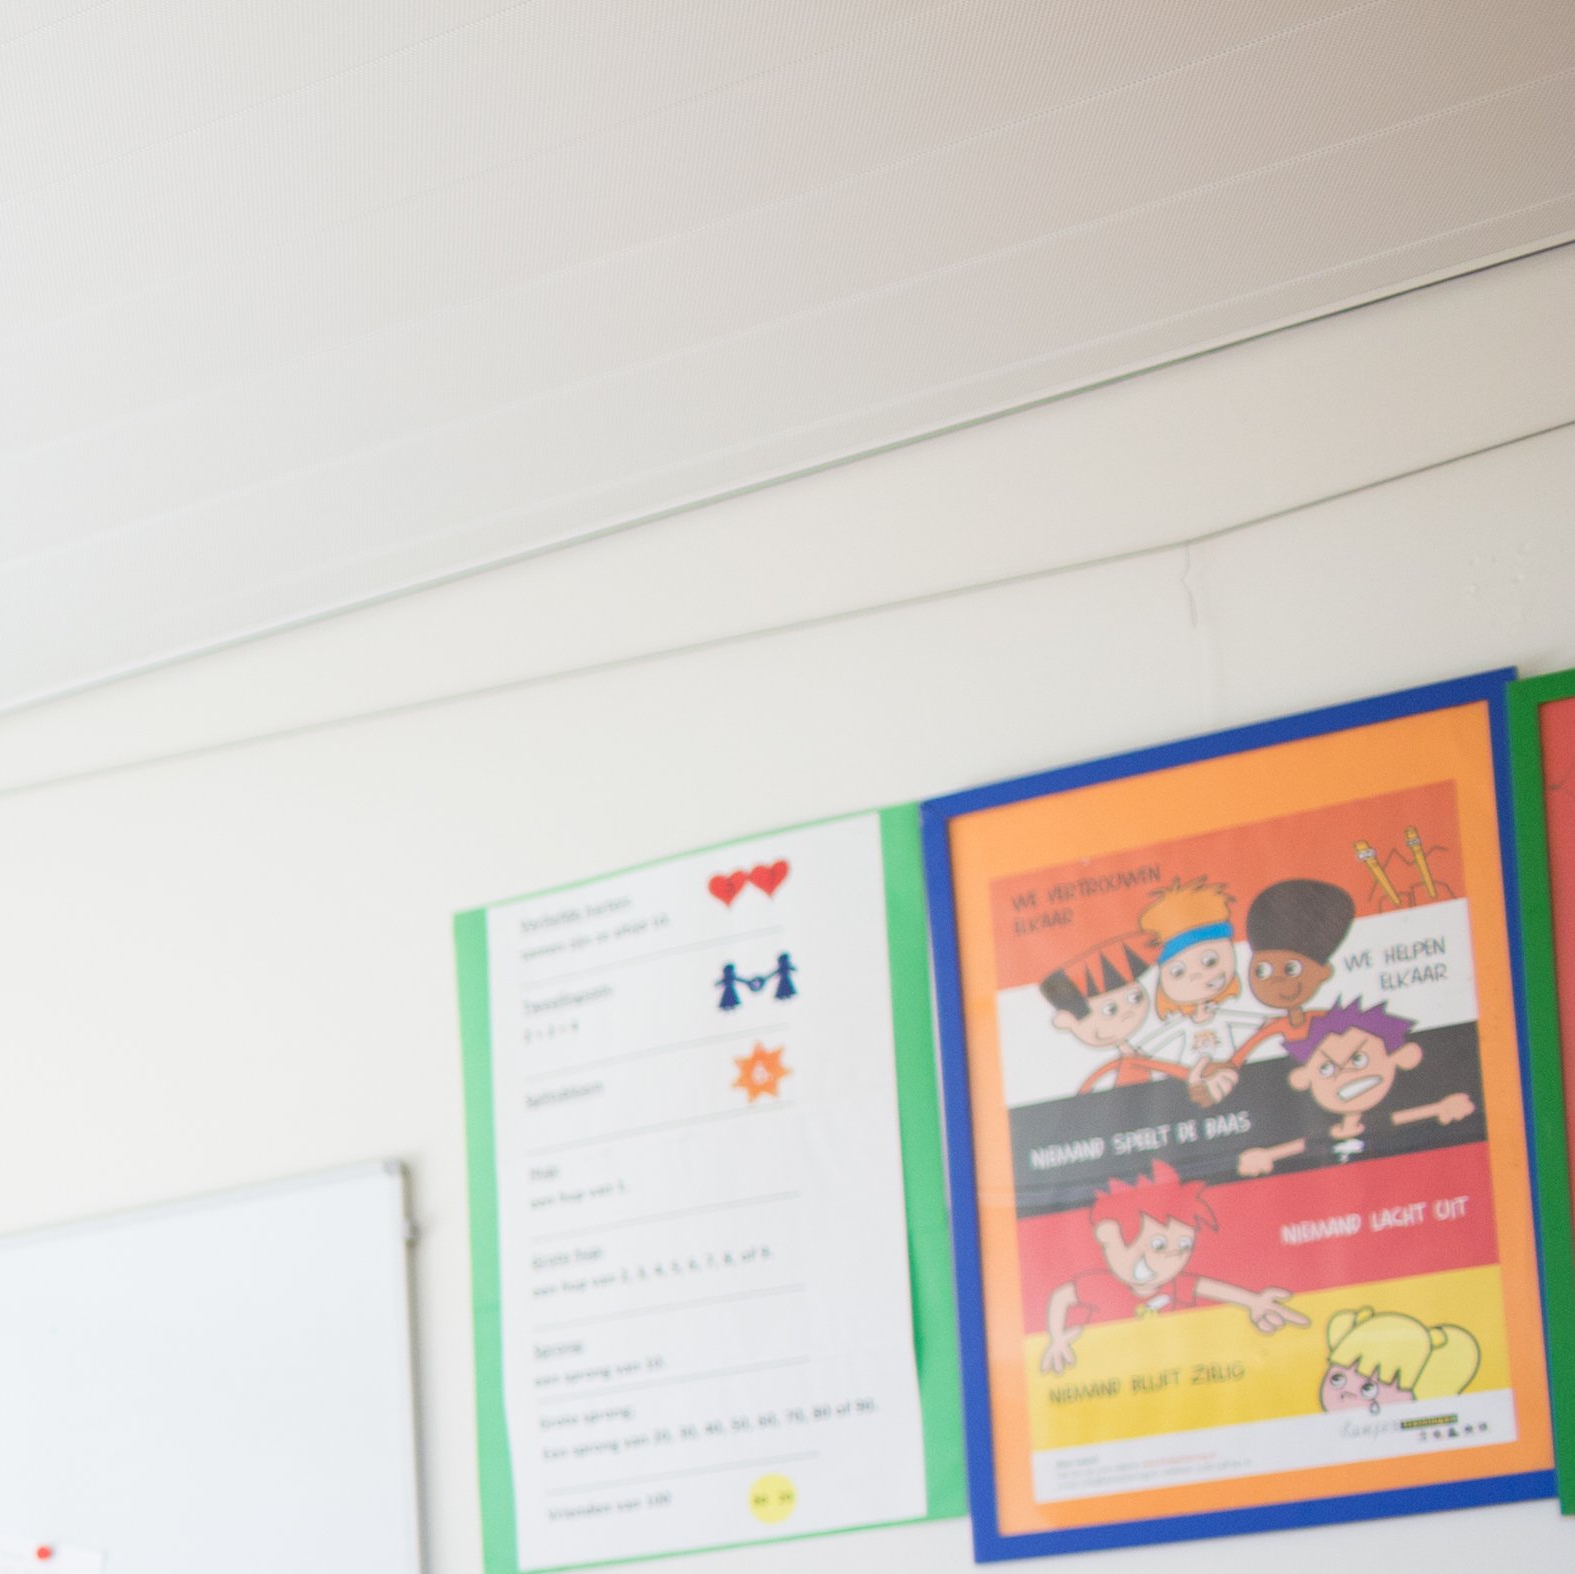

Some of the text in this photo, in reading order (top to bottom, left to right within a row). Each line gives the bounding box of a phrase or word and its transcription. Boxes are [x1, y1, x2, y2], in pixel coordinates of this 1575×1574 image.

[1344, 936, 1445, 972] WE HELPEN
[1380, 962, 1448, 991] ELKAAR
[1030, 1110, 1251, 1169] NIEMAND SPEELT DE BAAS
[1281, 1196, 1469, 1244] NIEMAND LACHT UIT
[1049, 1361, 1246, 1405] NIEMAND BLIJFT ZIELIG
